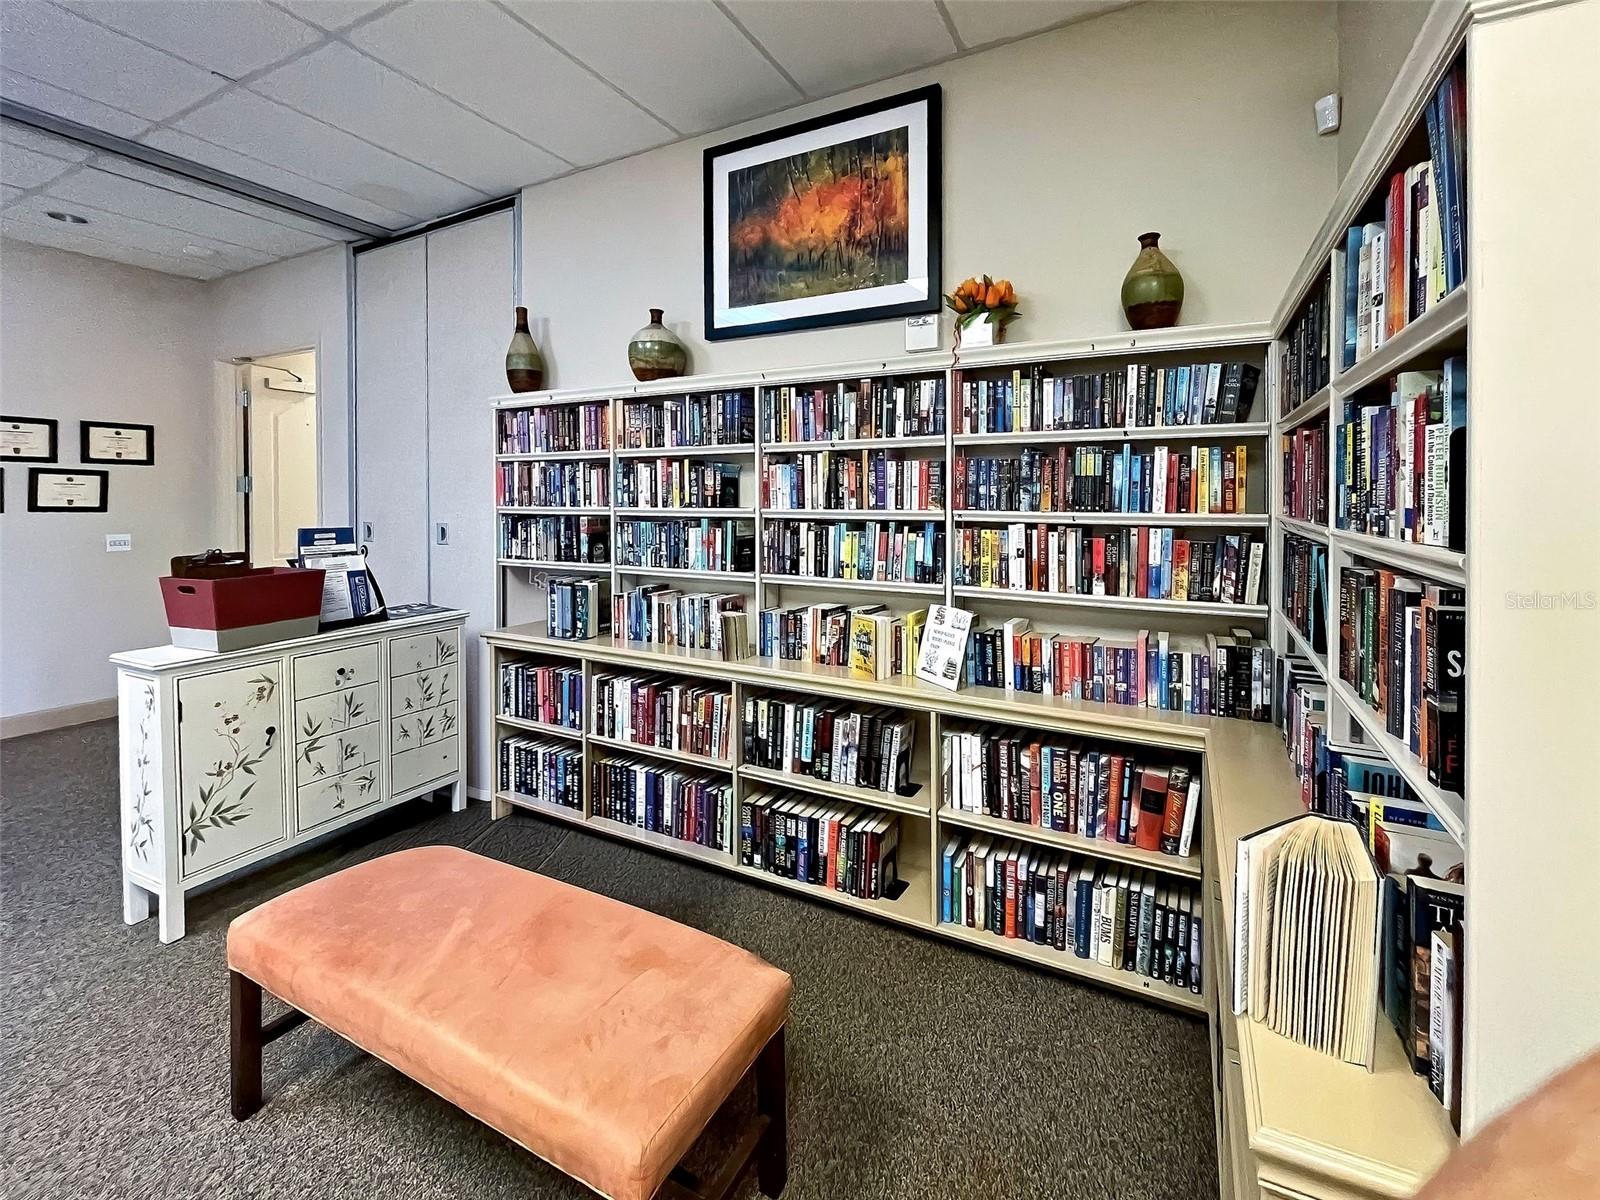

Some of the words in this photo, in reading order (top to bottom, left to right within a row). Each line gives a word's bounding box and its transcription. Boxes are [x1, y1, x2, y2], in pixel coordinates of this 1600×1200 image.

[1435, 428, 1444, 461] PETER
[1435, 464, 1444, 521] ROBINSON
[1394, 612, 1402, 638] TRUST
[1394, 640, 1402, 653] ME
[1426, 645, 1434, 690] SANDFORD
[1000, 745, 1008, 768] DRIVER
[1060, 759, 1068, 784] JANET
[1022, 775, 1030, 805] MIDDLESEX
[1053, 792, 1063, 818] ONE
[1130, 892, 1139, 905] SUE
[1100, 915, 1112, 944] BUMS
[1129, 906, 1138, 937] GRAFTON
[1431, 1048, 1442, 1090] AGAIN
